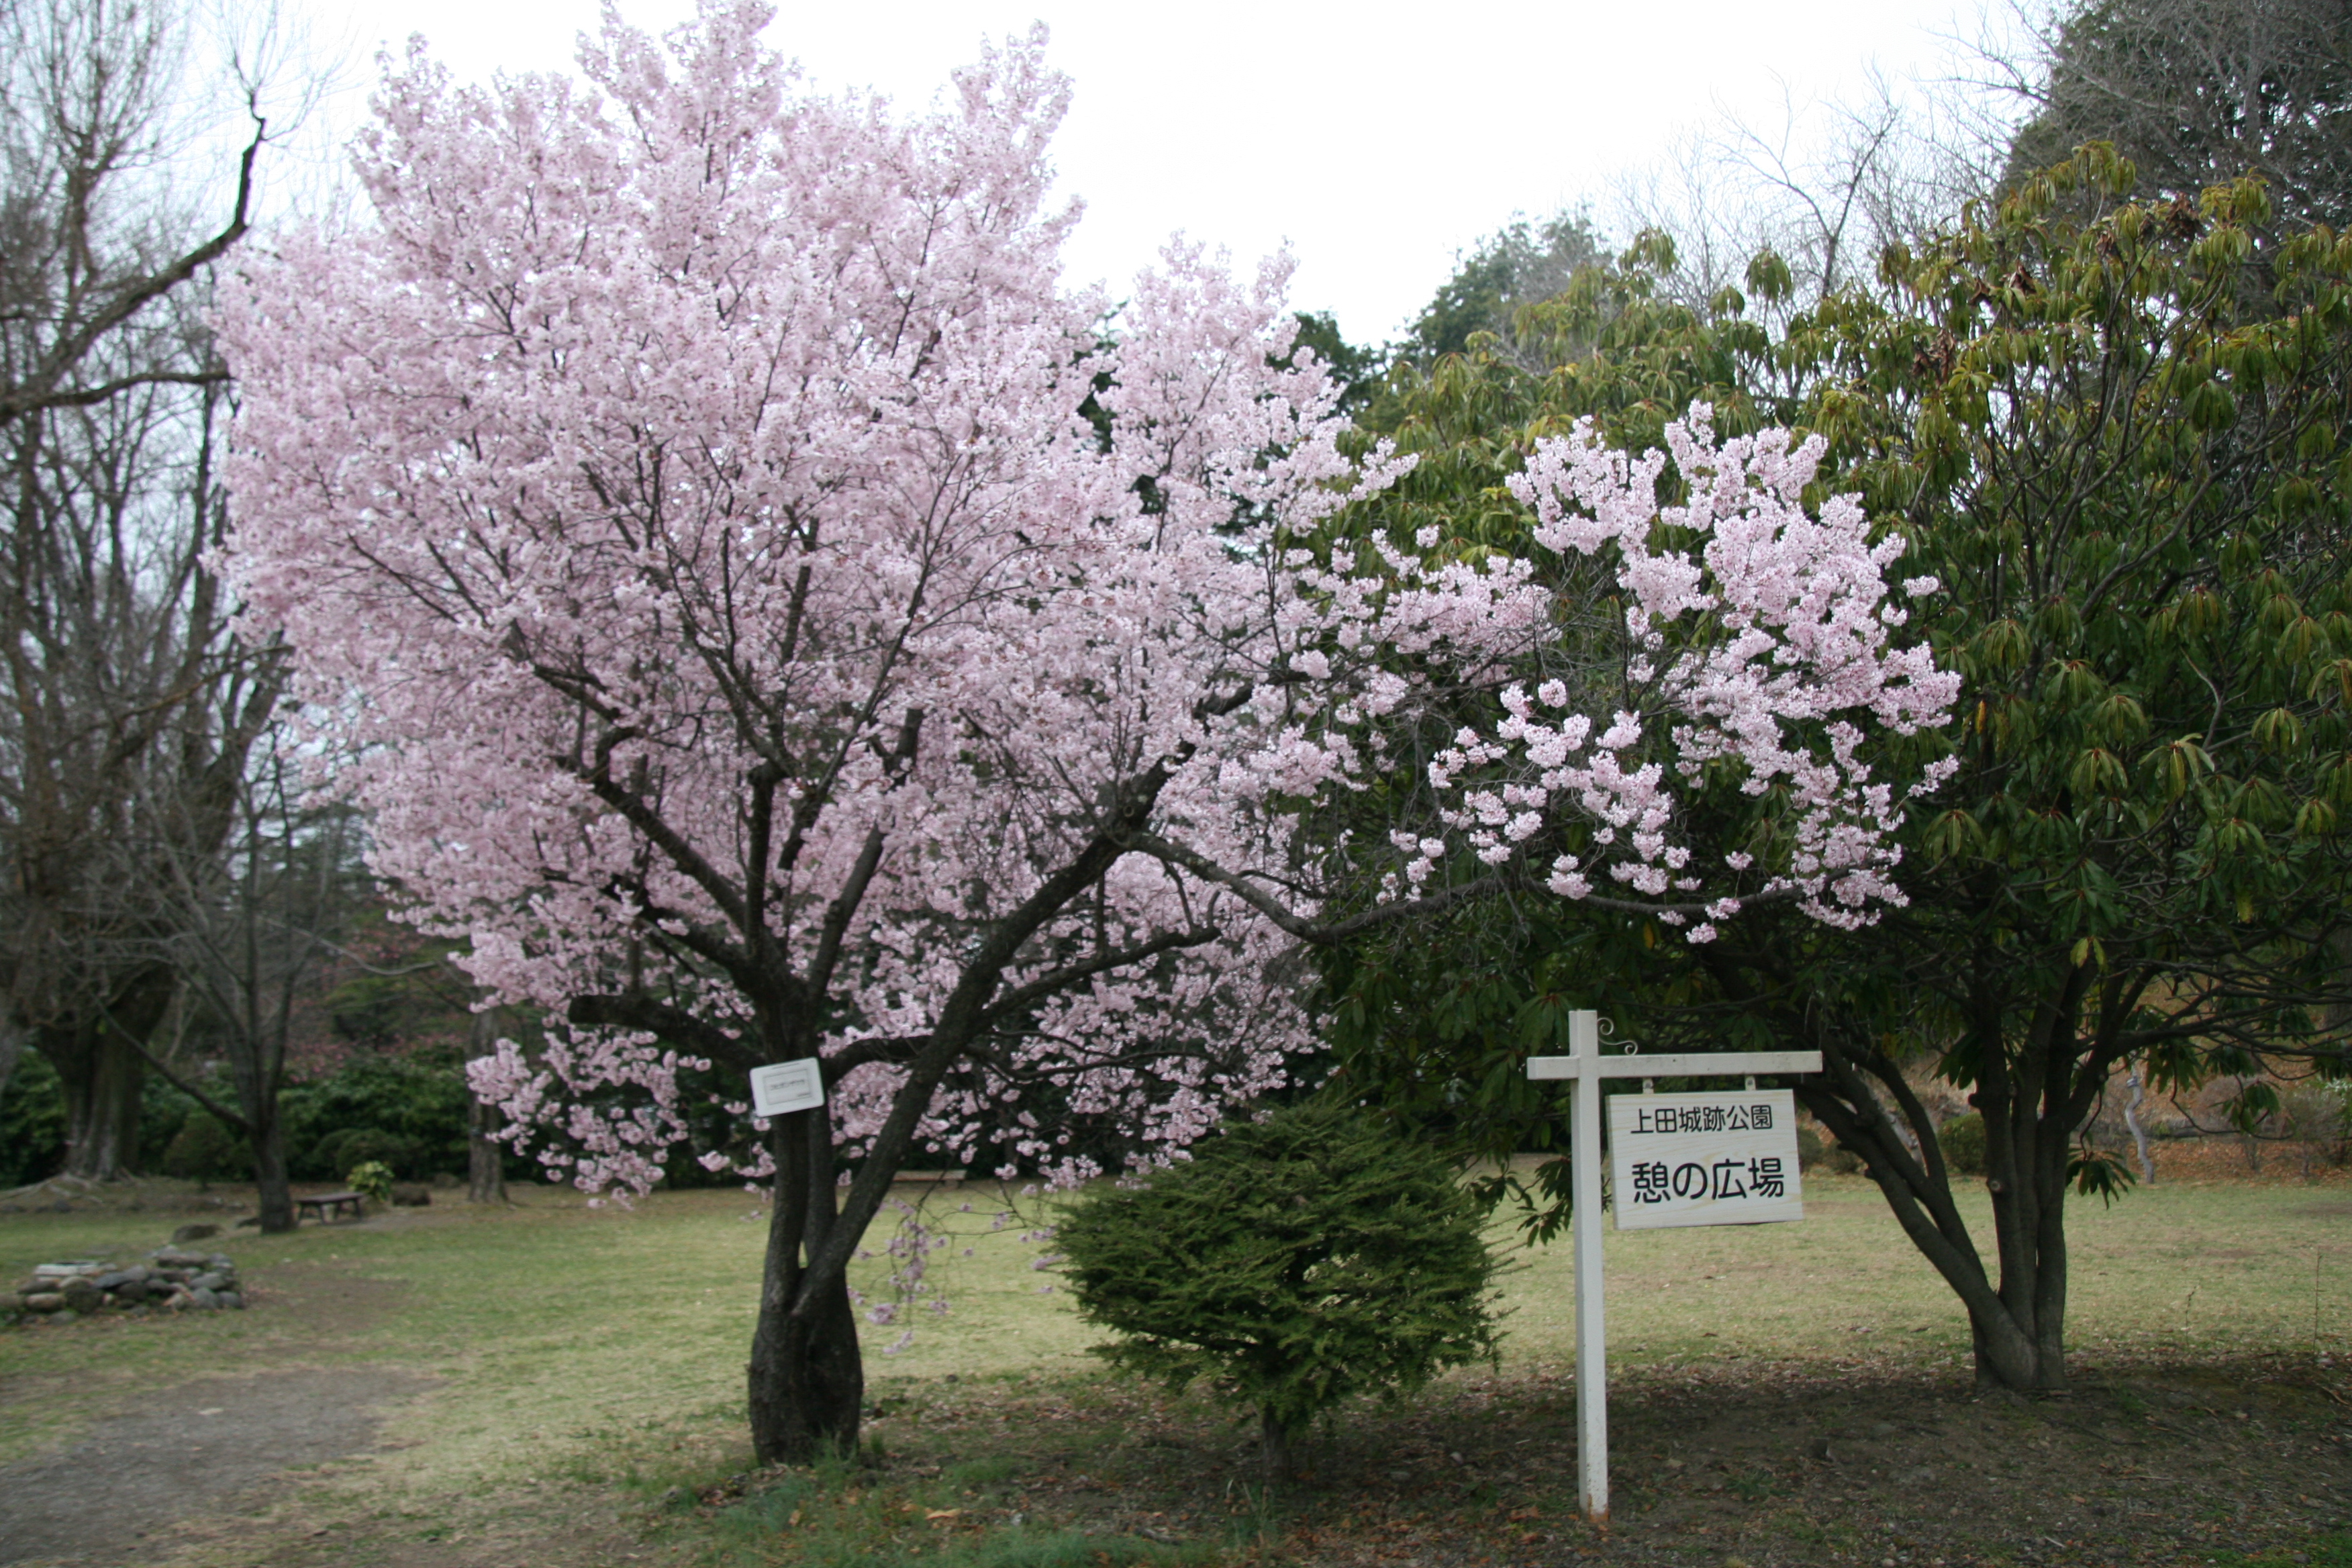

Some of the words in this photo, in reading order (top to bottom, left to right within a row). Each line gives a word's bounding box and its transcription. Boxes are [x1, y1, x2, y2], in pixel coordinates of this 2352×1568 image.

[1630, 1104, 1773, 1134] 上田城跡公園
[1632, 1157, 1784, 1203] 憩の広場
